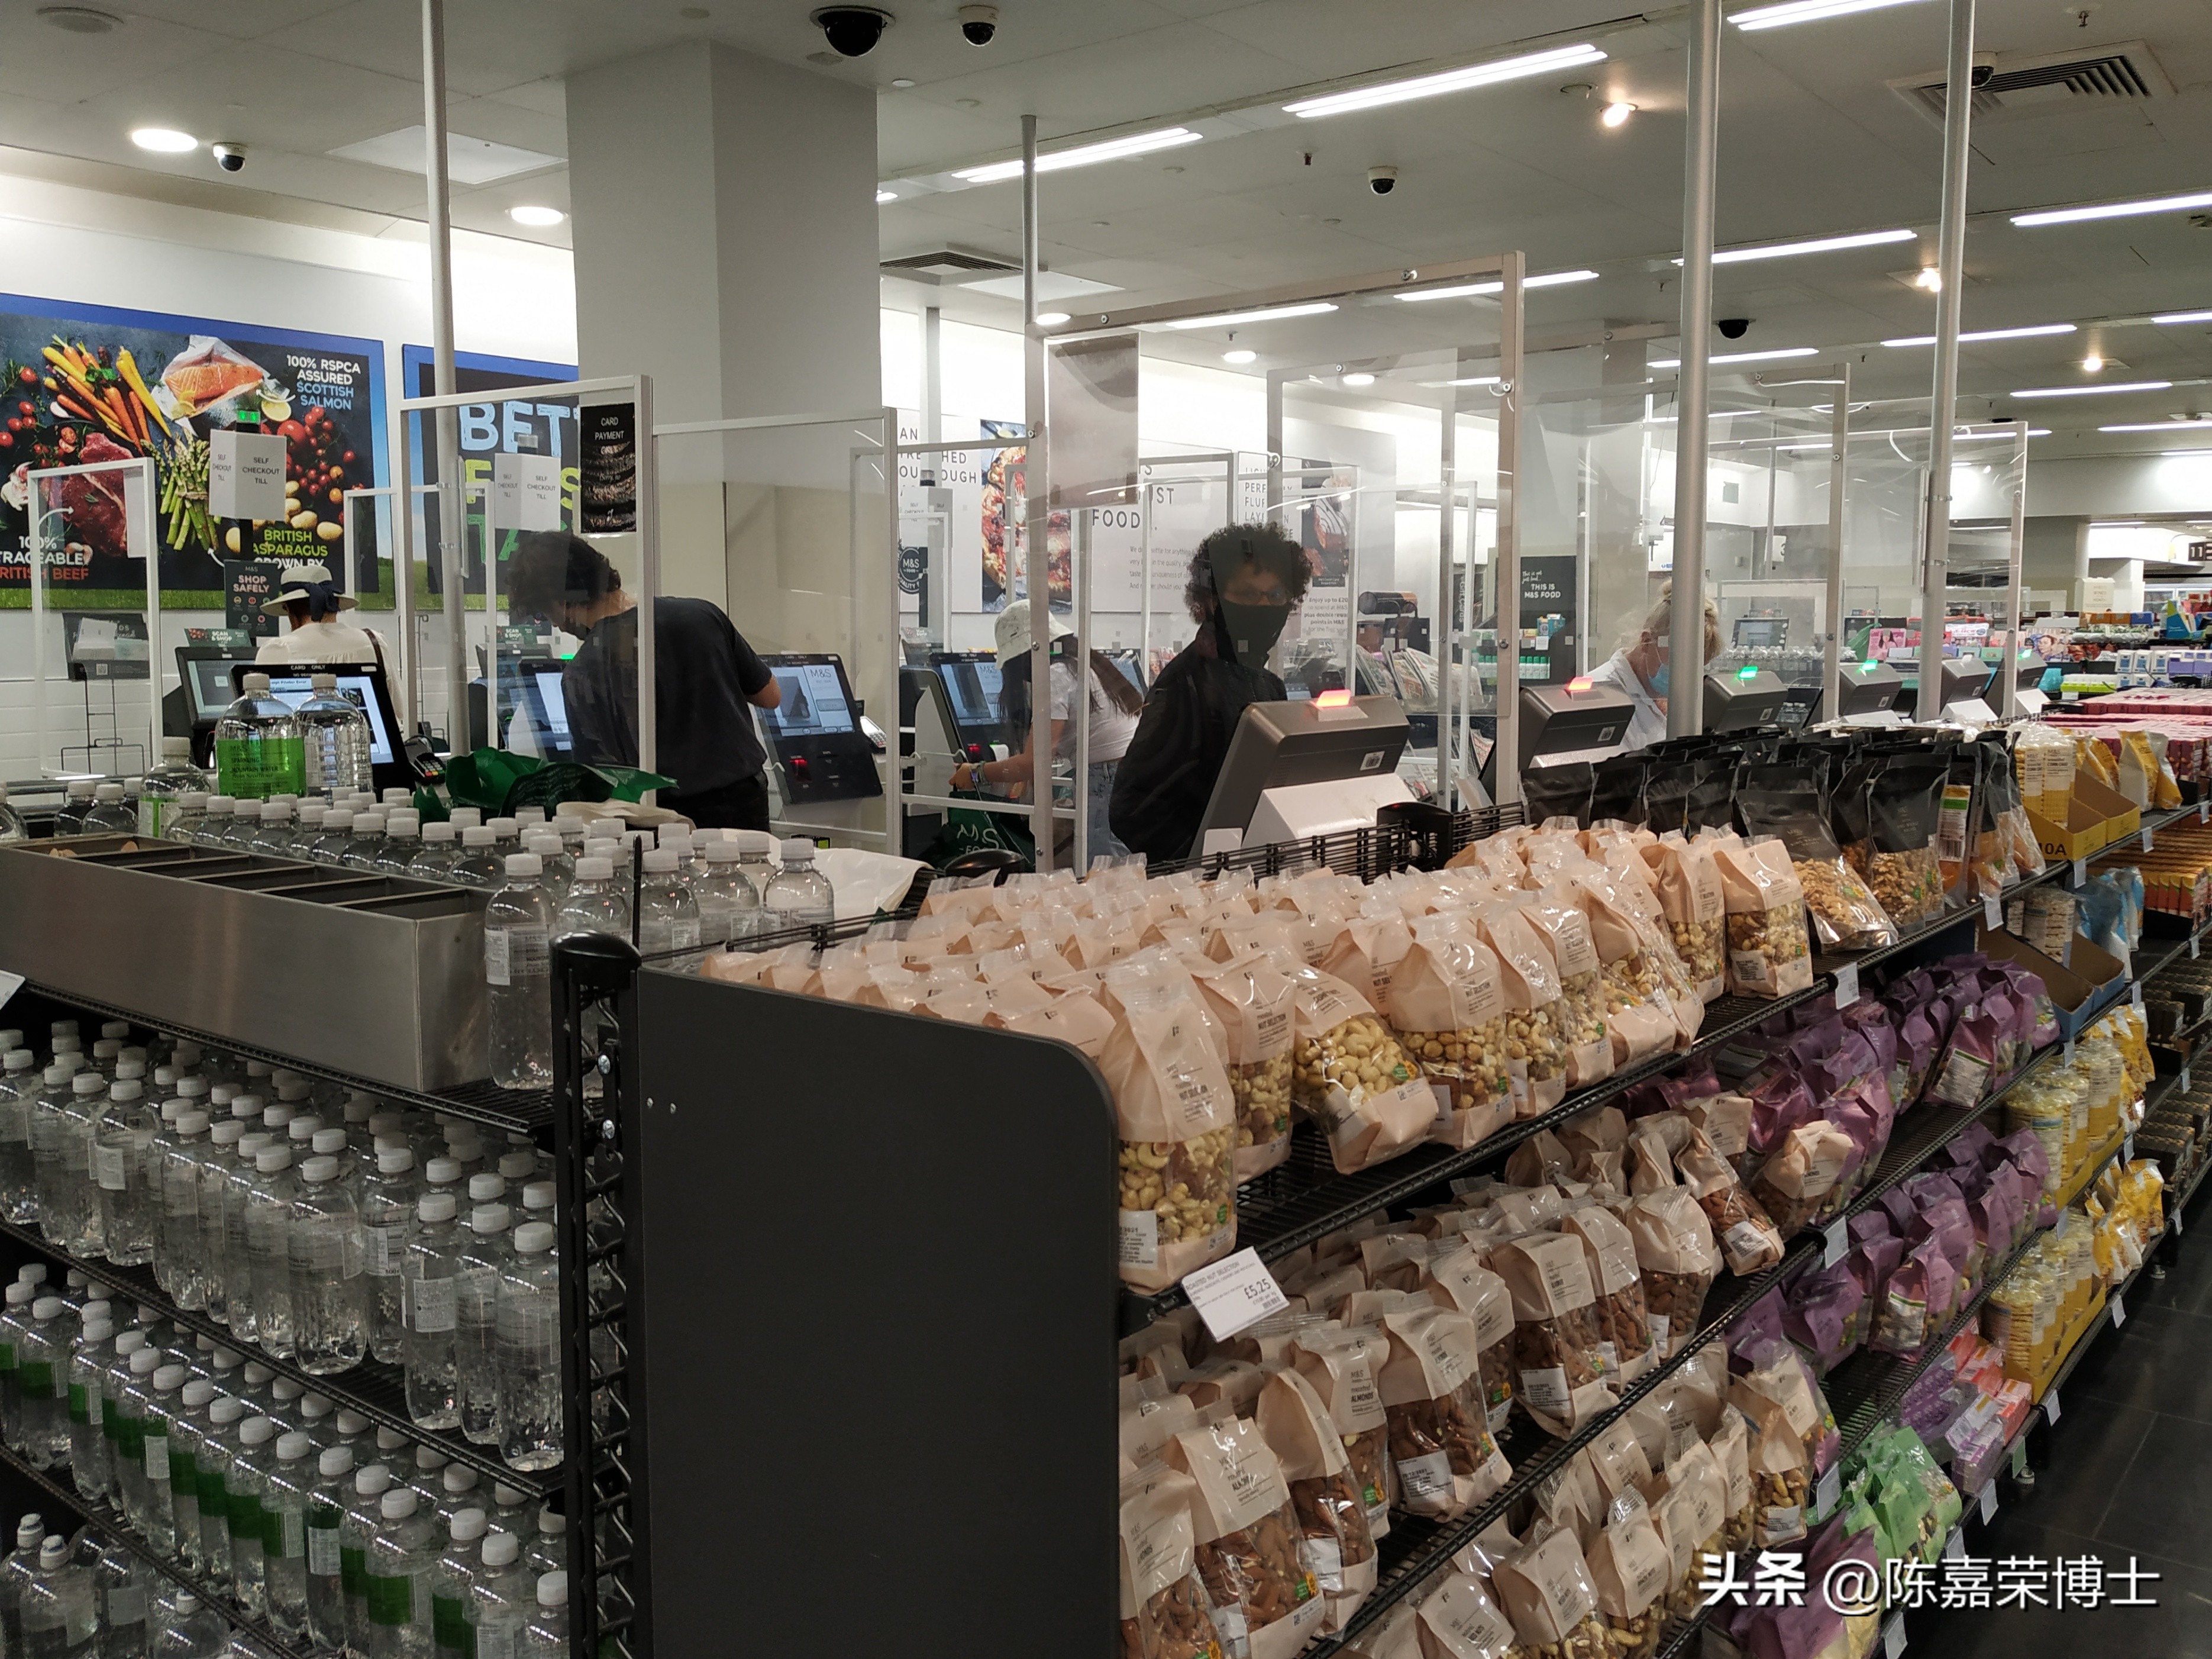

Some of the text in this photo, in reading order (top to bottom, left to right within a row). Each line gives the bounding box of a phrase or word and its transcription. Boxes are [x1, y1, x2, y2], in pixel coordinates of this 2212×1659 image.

[287, 355, 361, 374] 100% RSPCA
[297, 369, 353, 385] ASSURED
[296, 380, 354, 398] SCOTTISH
[301, 395, 351, 410] SALMON
[601, 417, 619, 426] CARD
[595, 431, 625, 440] PAYMENT
[264, 529, 312, 543] BRITISH
[253, 543, 328, 557] ASPARAGUS
[2191, 546, 2203, 557] 11
[903, 558, 920, 568] M&S
[53, 568, 89, 580] BEEF
[238, 574, 267, 584] SHOP
[233, 583, 270, 593] SAFELY
[810, 669, 831, 678] M&S
[1244, 1278, 1271, 1300] £5.25
[1351, 1369, 1364, 1379] M&S
[1351, 1392, 1374, 1403] ALMONDS
